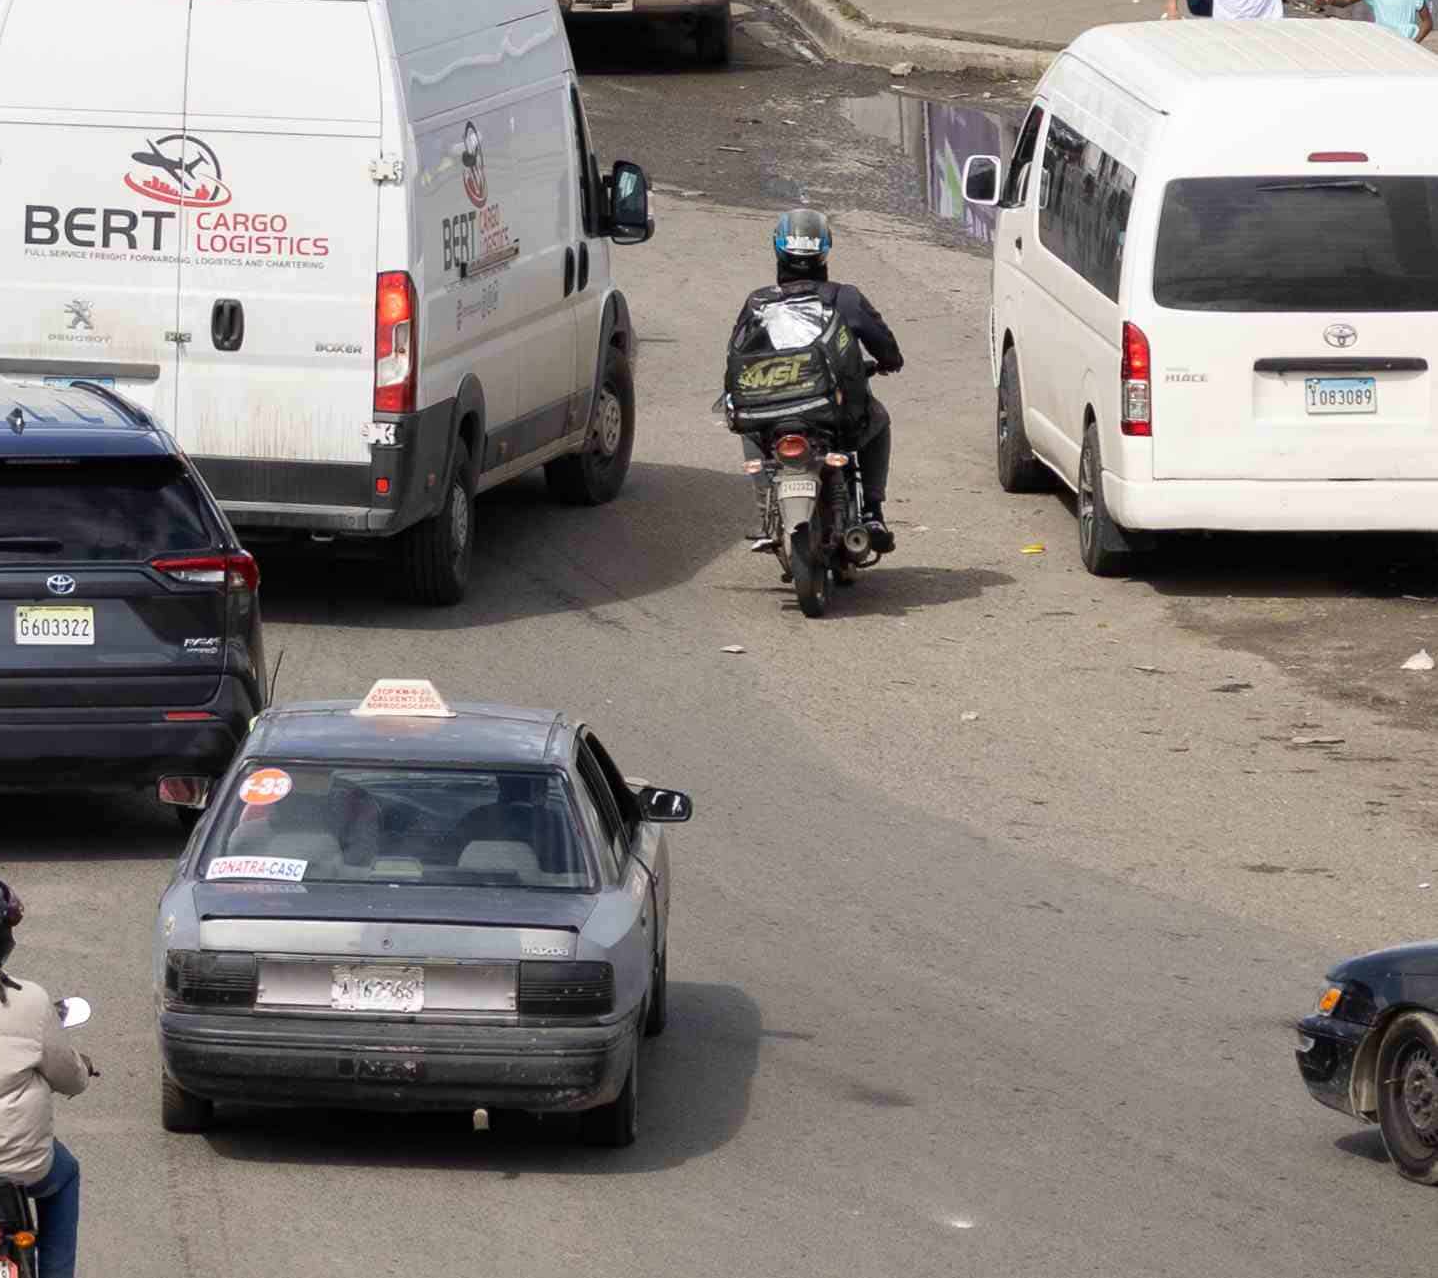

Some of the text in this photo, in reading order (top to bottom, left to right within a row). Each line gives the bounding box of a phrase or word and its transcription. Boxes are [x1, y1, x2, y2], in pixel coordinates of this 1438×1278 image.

[25, 204, 287, 252] BERT CARGO
[196, 233, 329, 257] LOGISTICS
[24, 249, 44, 257] FULL
[46, 250, 87, 259] SERVICE
[89, 252, 128, 261] FREIGHT
[195, 258, 243, 267] LOGISTICS
[244, 259, 260, 268] AND
[261, 260, 325, 270] CHARTERING
[1164, 373, 1208, 383] HIACE
[21, 618, 90, 638] G603322
